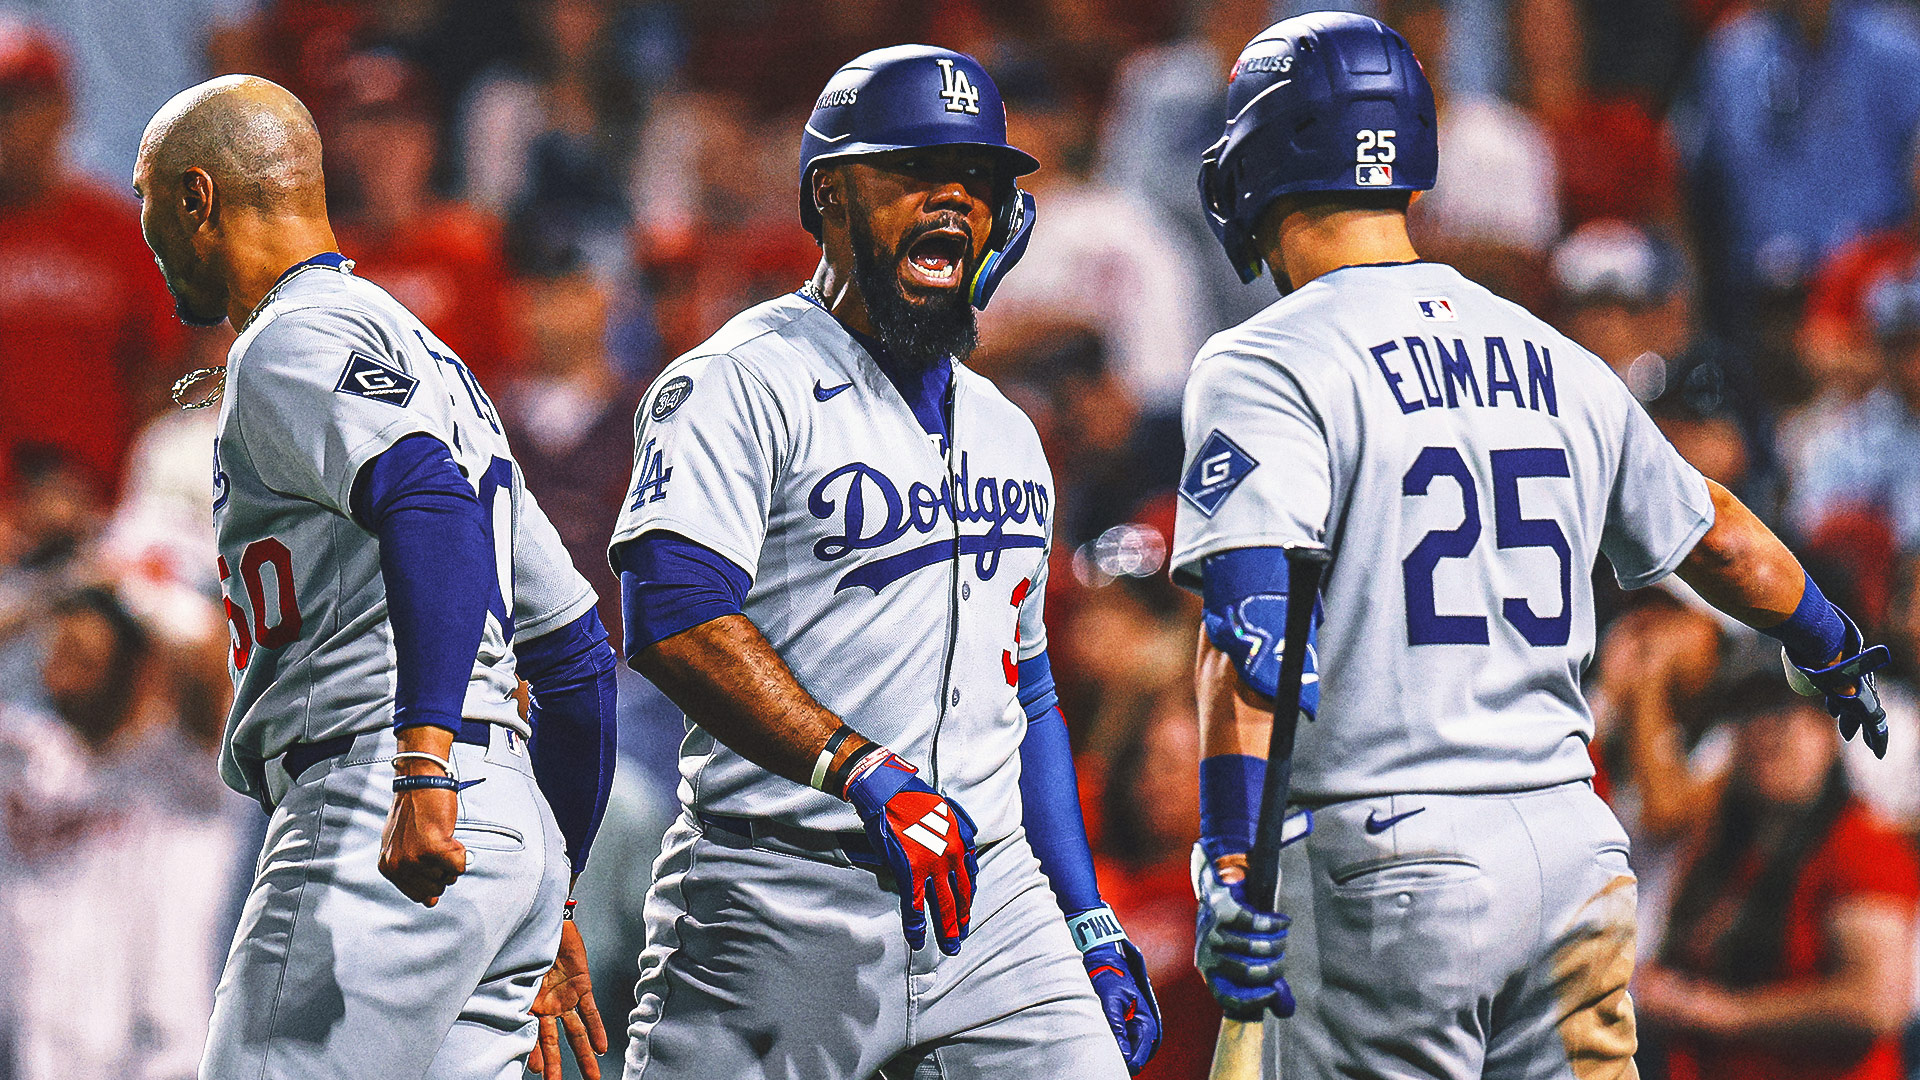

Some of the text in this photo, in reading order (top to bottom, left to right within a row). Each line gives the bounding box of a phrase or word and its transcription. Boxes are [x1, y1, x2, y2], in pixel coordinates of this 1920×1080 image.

[936, 59, 980, 115] LA
[1356, 128, 1397, 163] 25
[655, 387, 682, 415] 34
[1369, 335, 1559, 418] EDMAN
[630, 437, 673, 512] LA
[1401, 446, 1572, 648] 25
